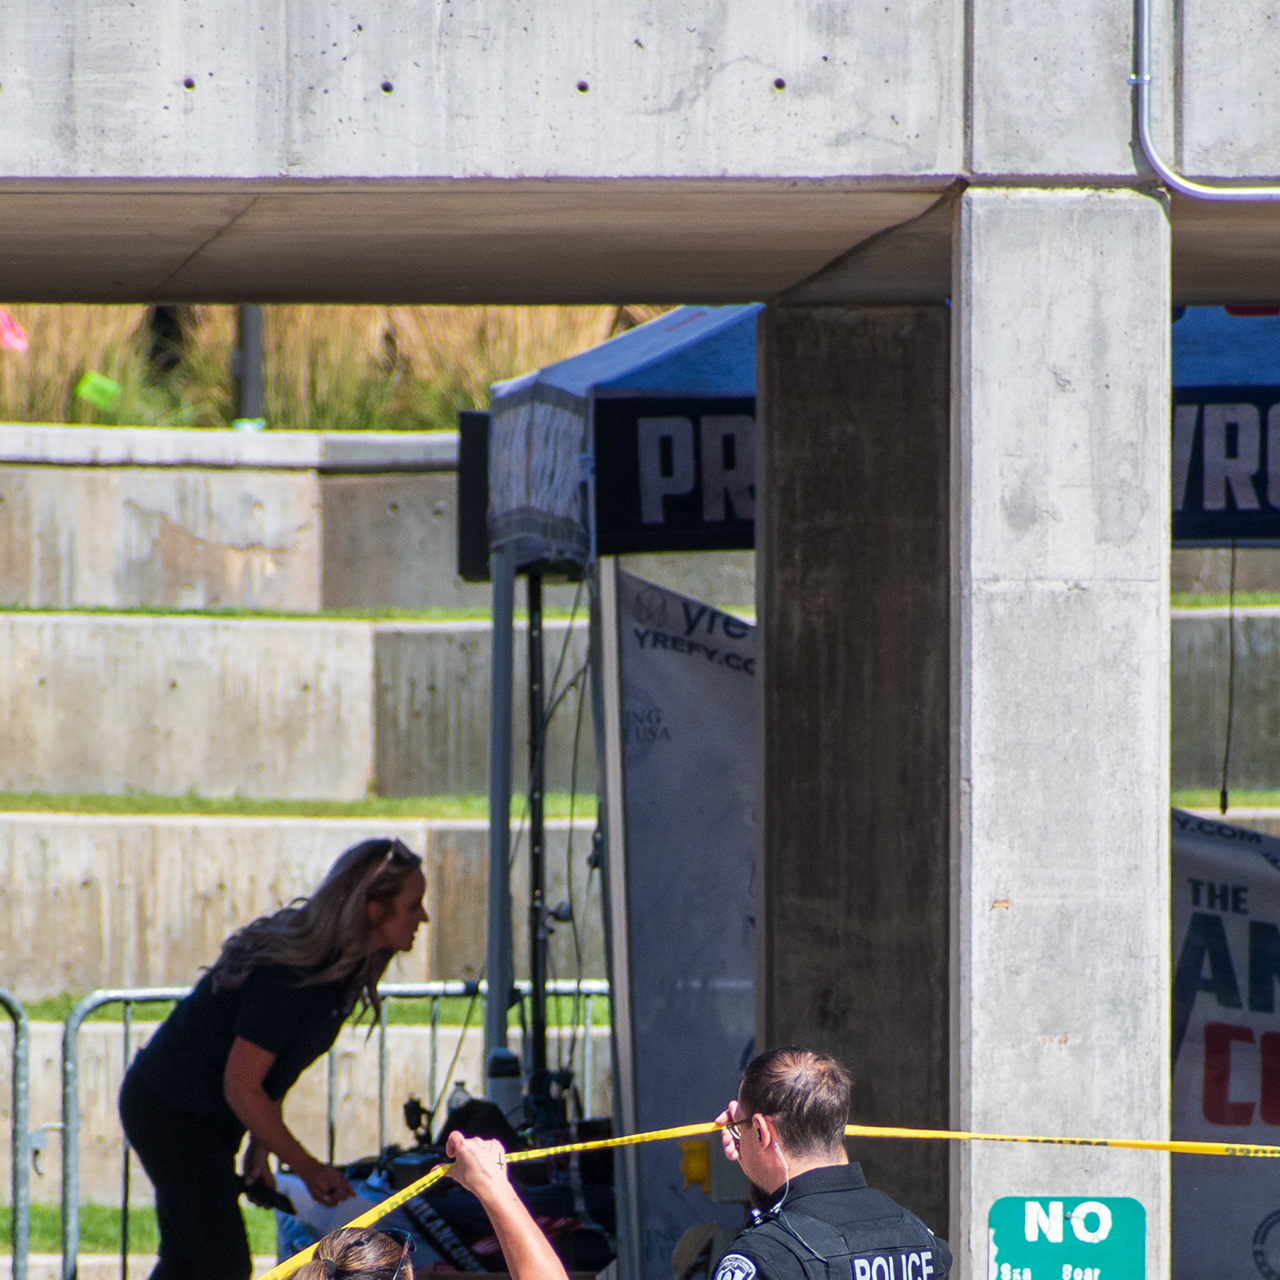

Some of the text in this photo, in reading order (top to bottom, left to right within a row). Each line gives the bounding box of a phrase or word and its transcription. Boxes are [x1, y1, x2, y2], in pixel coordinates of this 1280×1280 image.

[637, 414, 756, 524] PR
[1187, 878, 1249, 915] THE
[1024, 1201, 1112, 1243] NO
